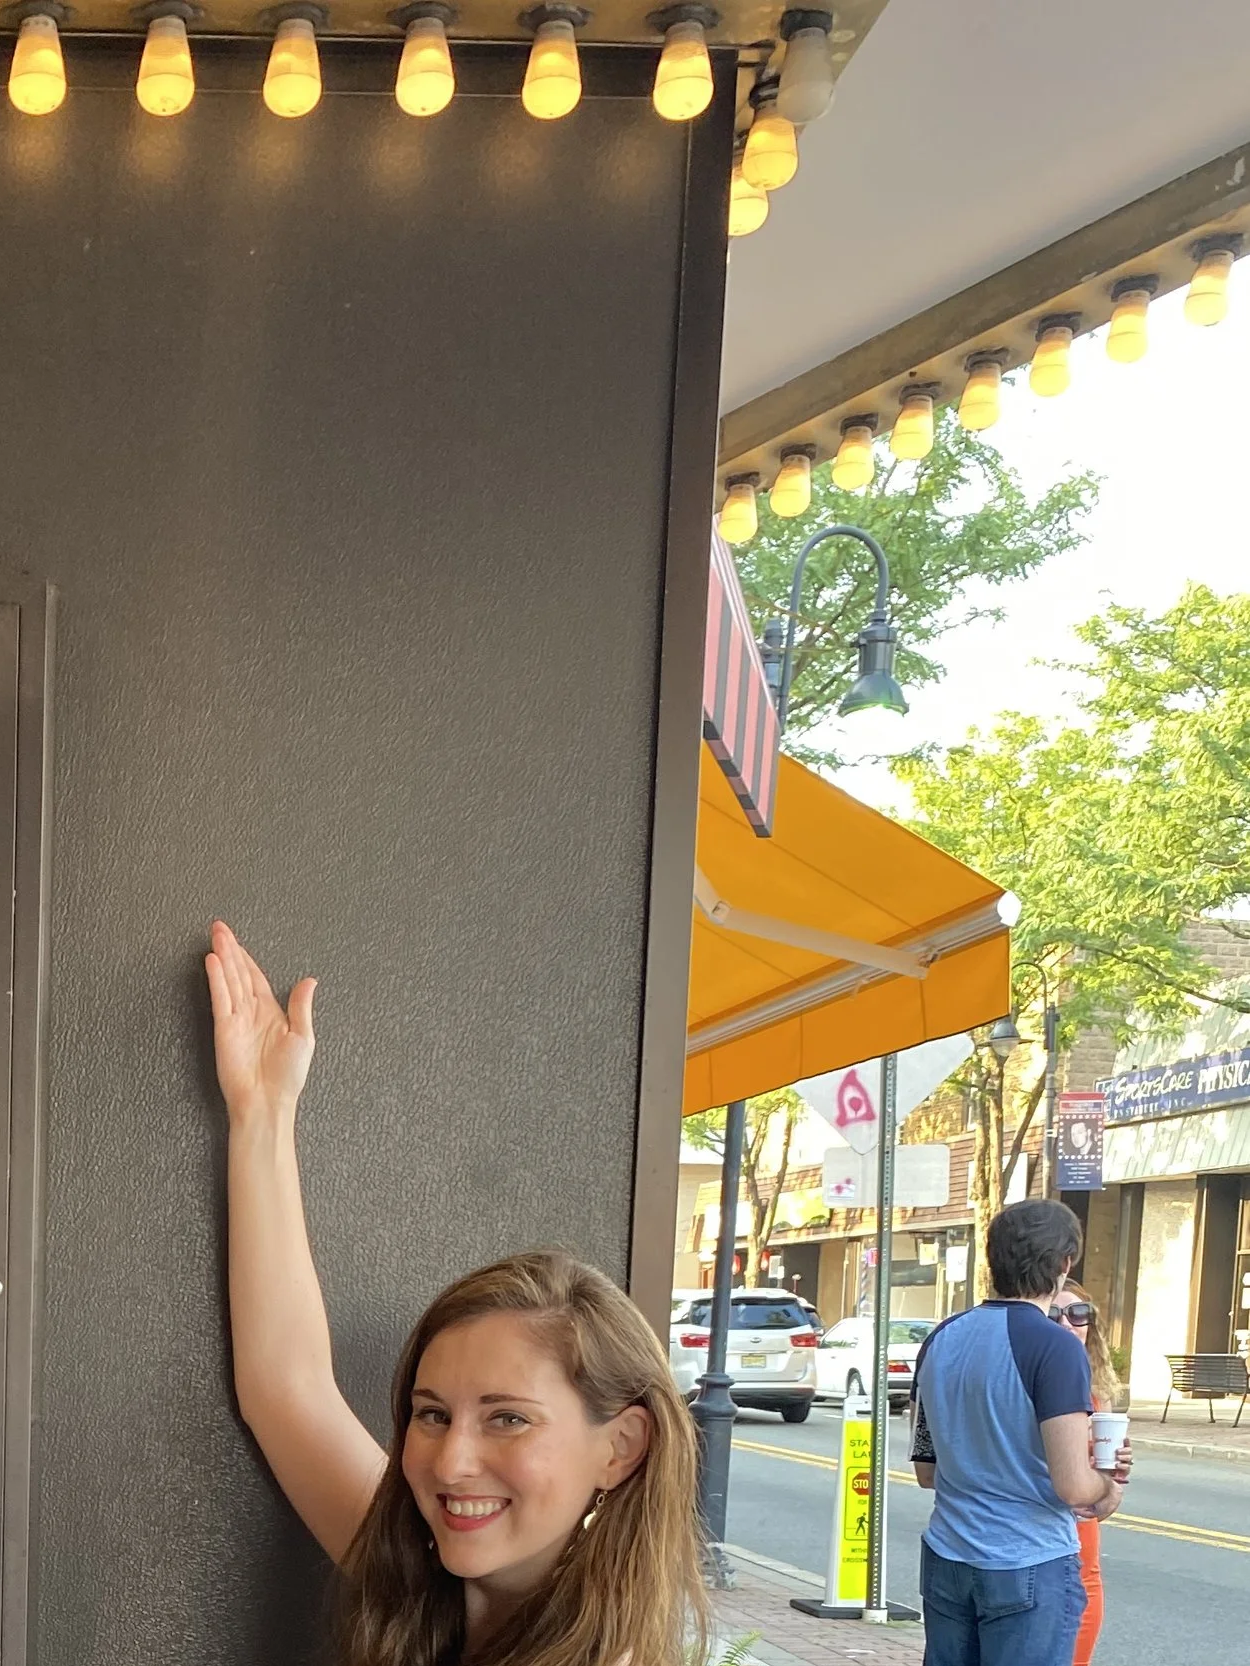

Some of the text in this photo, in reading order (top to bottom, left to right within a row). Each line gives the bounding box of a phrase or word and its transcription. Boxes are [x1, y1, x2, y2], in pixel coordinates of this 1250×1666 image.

[1197, 1060, 1250, 1095] PHYSIC
[849, 1439, 870, 1447] STA
[852, 1450, 871, 1459] LA
[853, 1479, 869, 1489] STO
